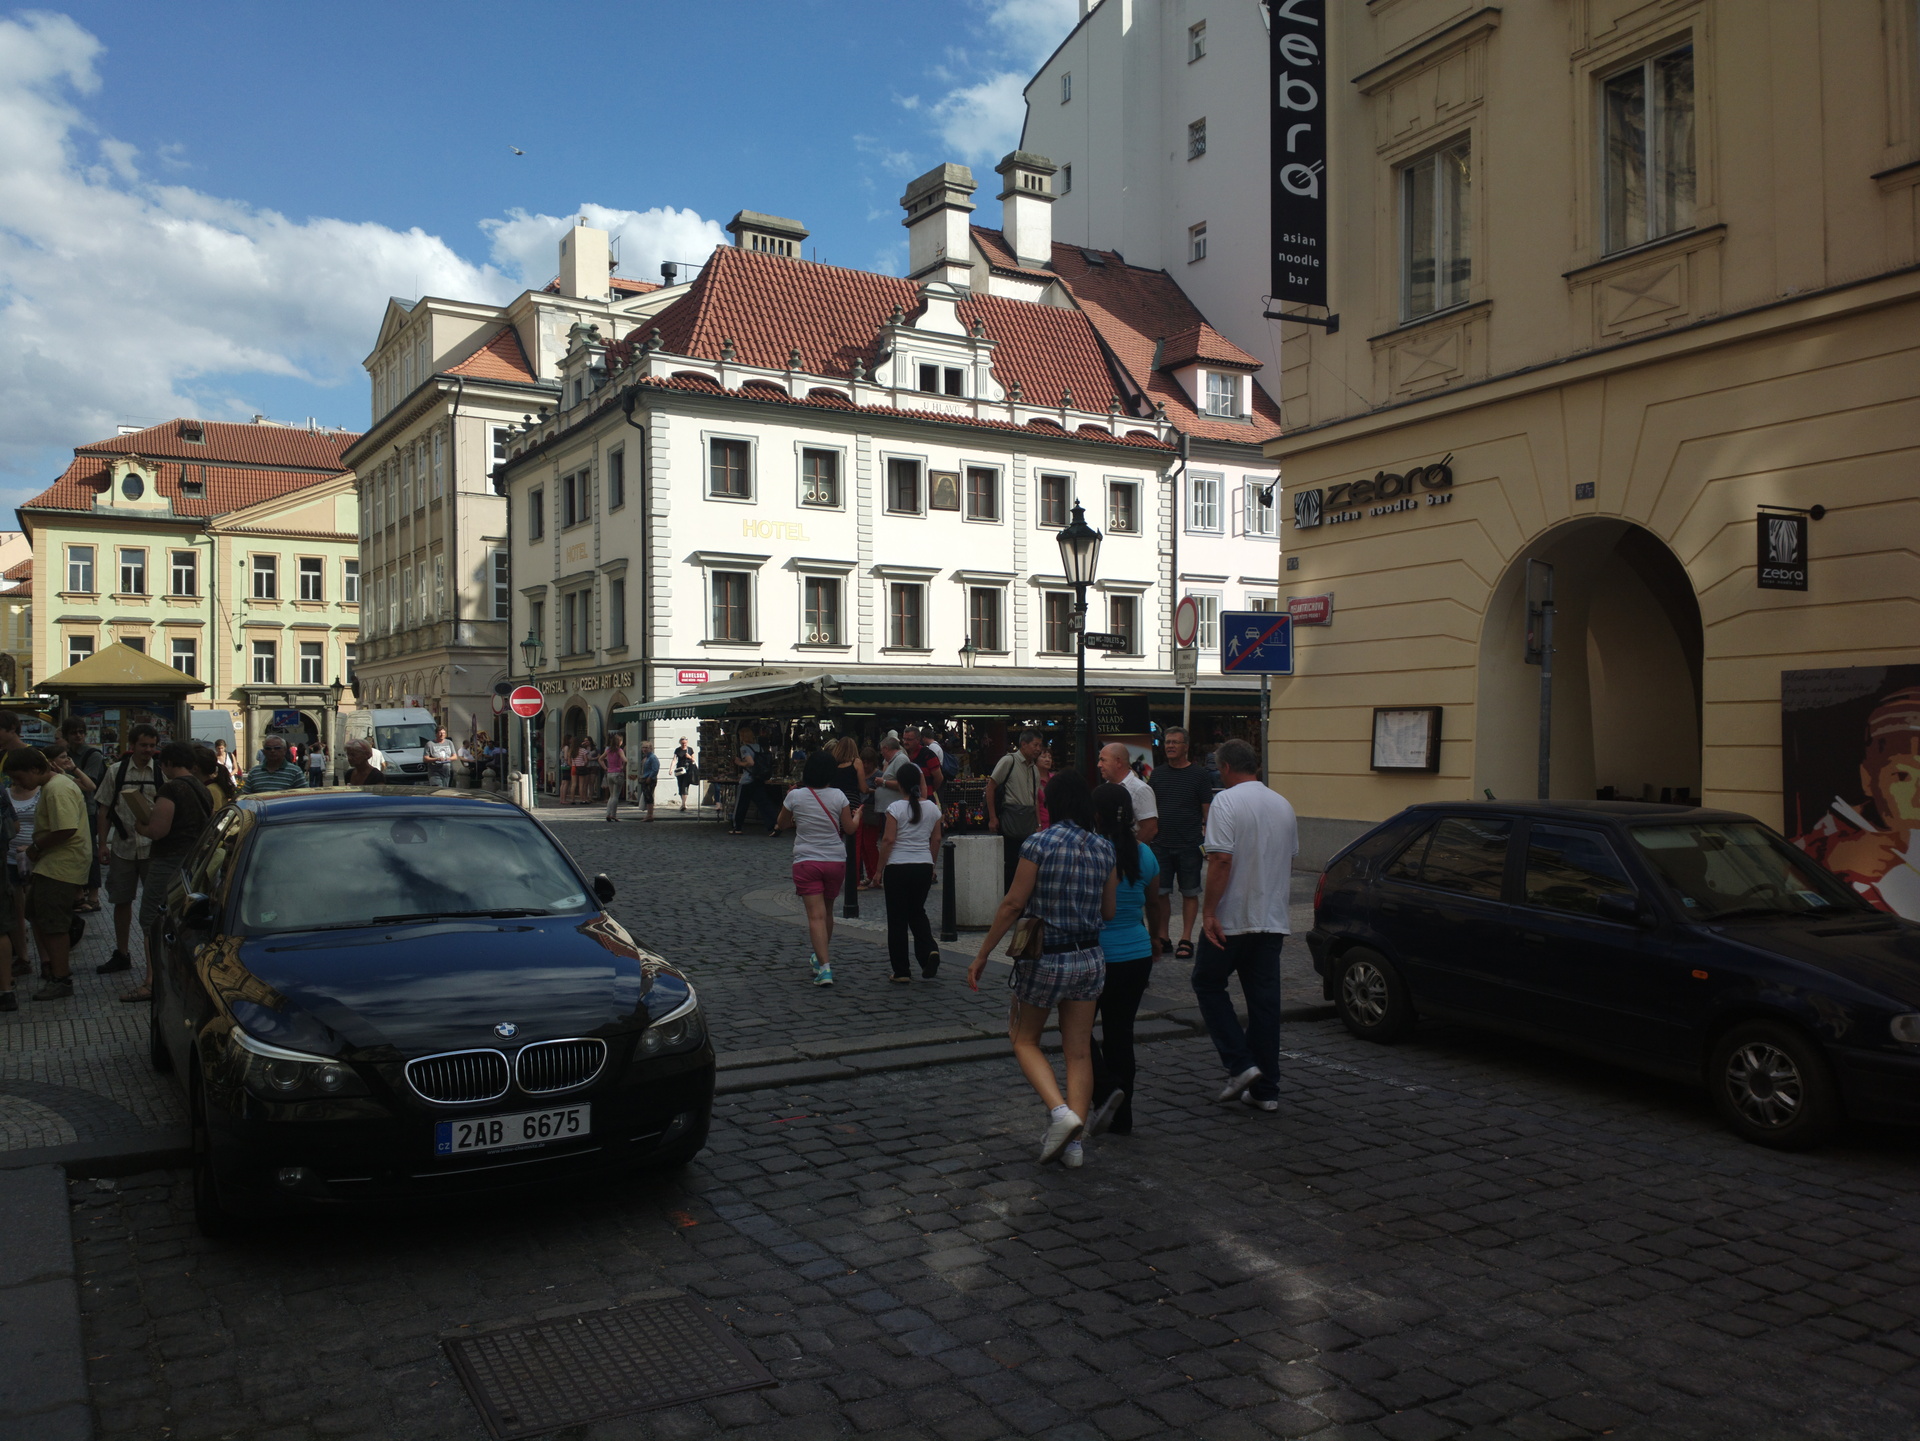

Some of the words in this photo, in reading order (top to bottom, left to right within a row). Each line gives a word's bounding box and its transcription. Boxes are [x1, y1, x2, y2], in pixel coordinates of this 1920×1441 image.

[1283, 232, 1316, 247] asian
[1279, 252, 1320, 267] noodle
[1289, 271, 1310, 285] bar
[1323, 452, 1454, 511] zebra
[1325, 510, 1360, 525] asian
[1369, 499, 1416, 517] noodle
[1426, 493, 1451, 506] bar
[742, 518, 810, 542] HOTEL
[566, 541, 588, 564] HOTEL
[1762, 568, 1804, 580] zebra
[541, 679, 565, 695] CRYSTAL
[580, 676, 600, 691] CZECH
[601, 675, 612, 689] ART
[612, 672, 632, 688] GLASS
[1095, 697, 1117, 706] PIZZA
[1096, 706, 1119, 715] PASTA
[1097, 715, 1124, 724] SALADS
[1097, 724, 1121, 733] STEAK
[458, 1120, 504, 1149] 2AB
[523, 1109, 580, 1139] 6675
[438, 1142, 450, 1150] CZ
